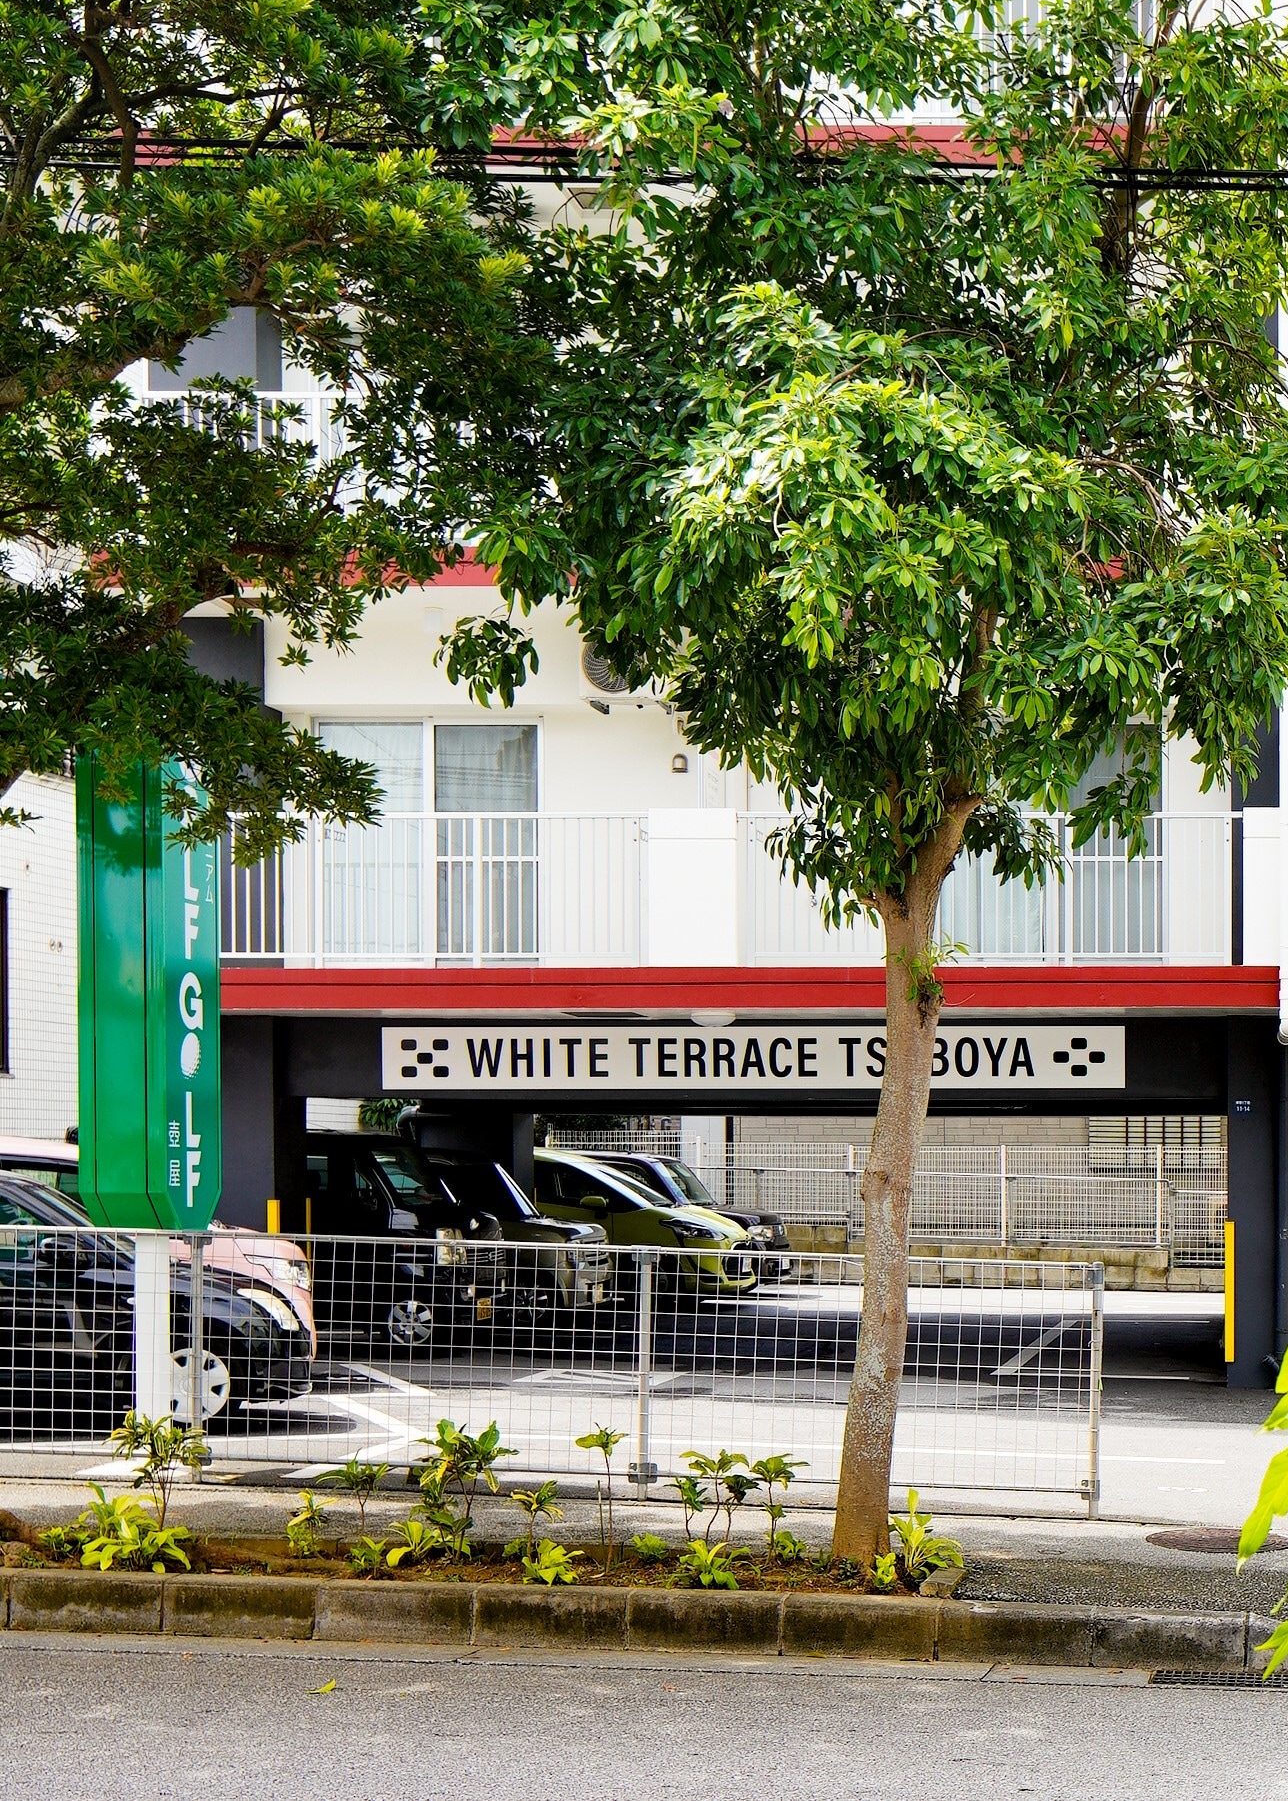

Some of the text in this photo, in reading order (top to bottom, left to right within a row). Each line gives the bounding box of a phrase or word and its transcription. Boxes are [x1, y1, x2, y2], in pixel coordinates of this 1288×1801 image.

[466, 1036, 1035, 1078] WHITE TERRACE TSBOYA
